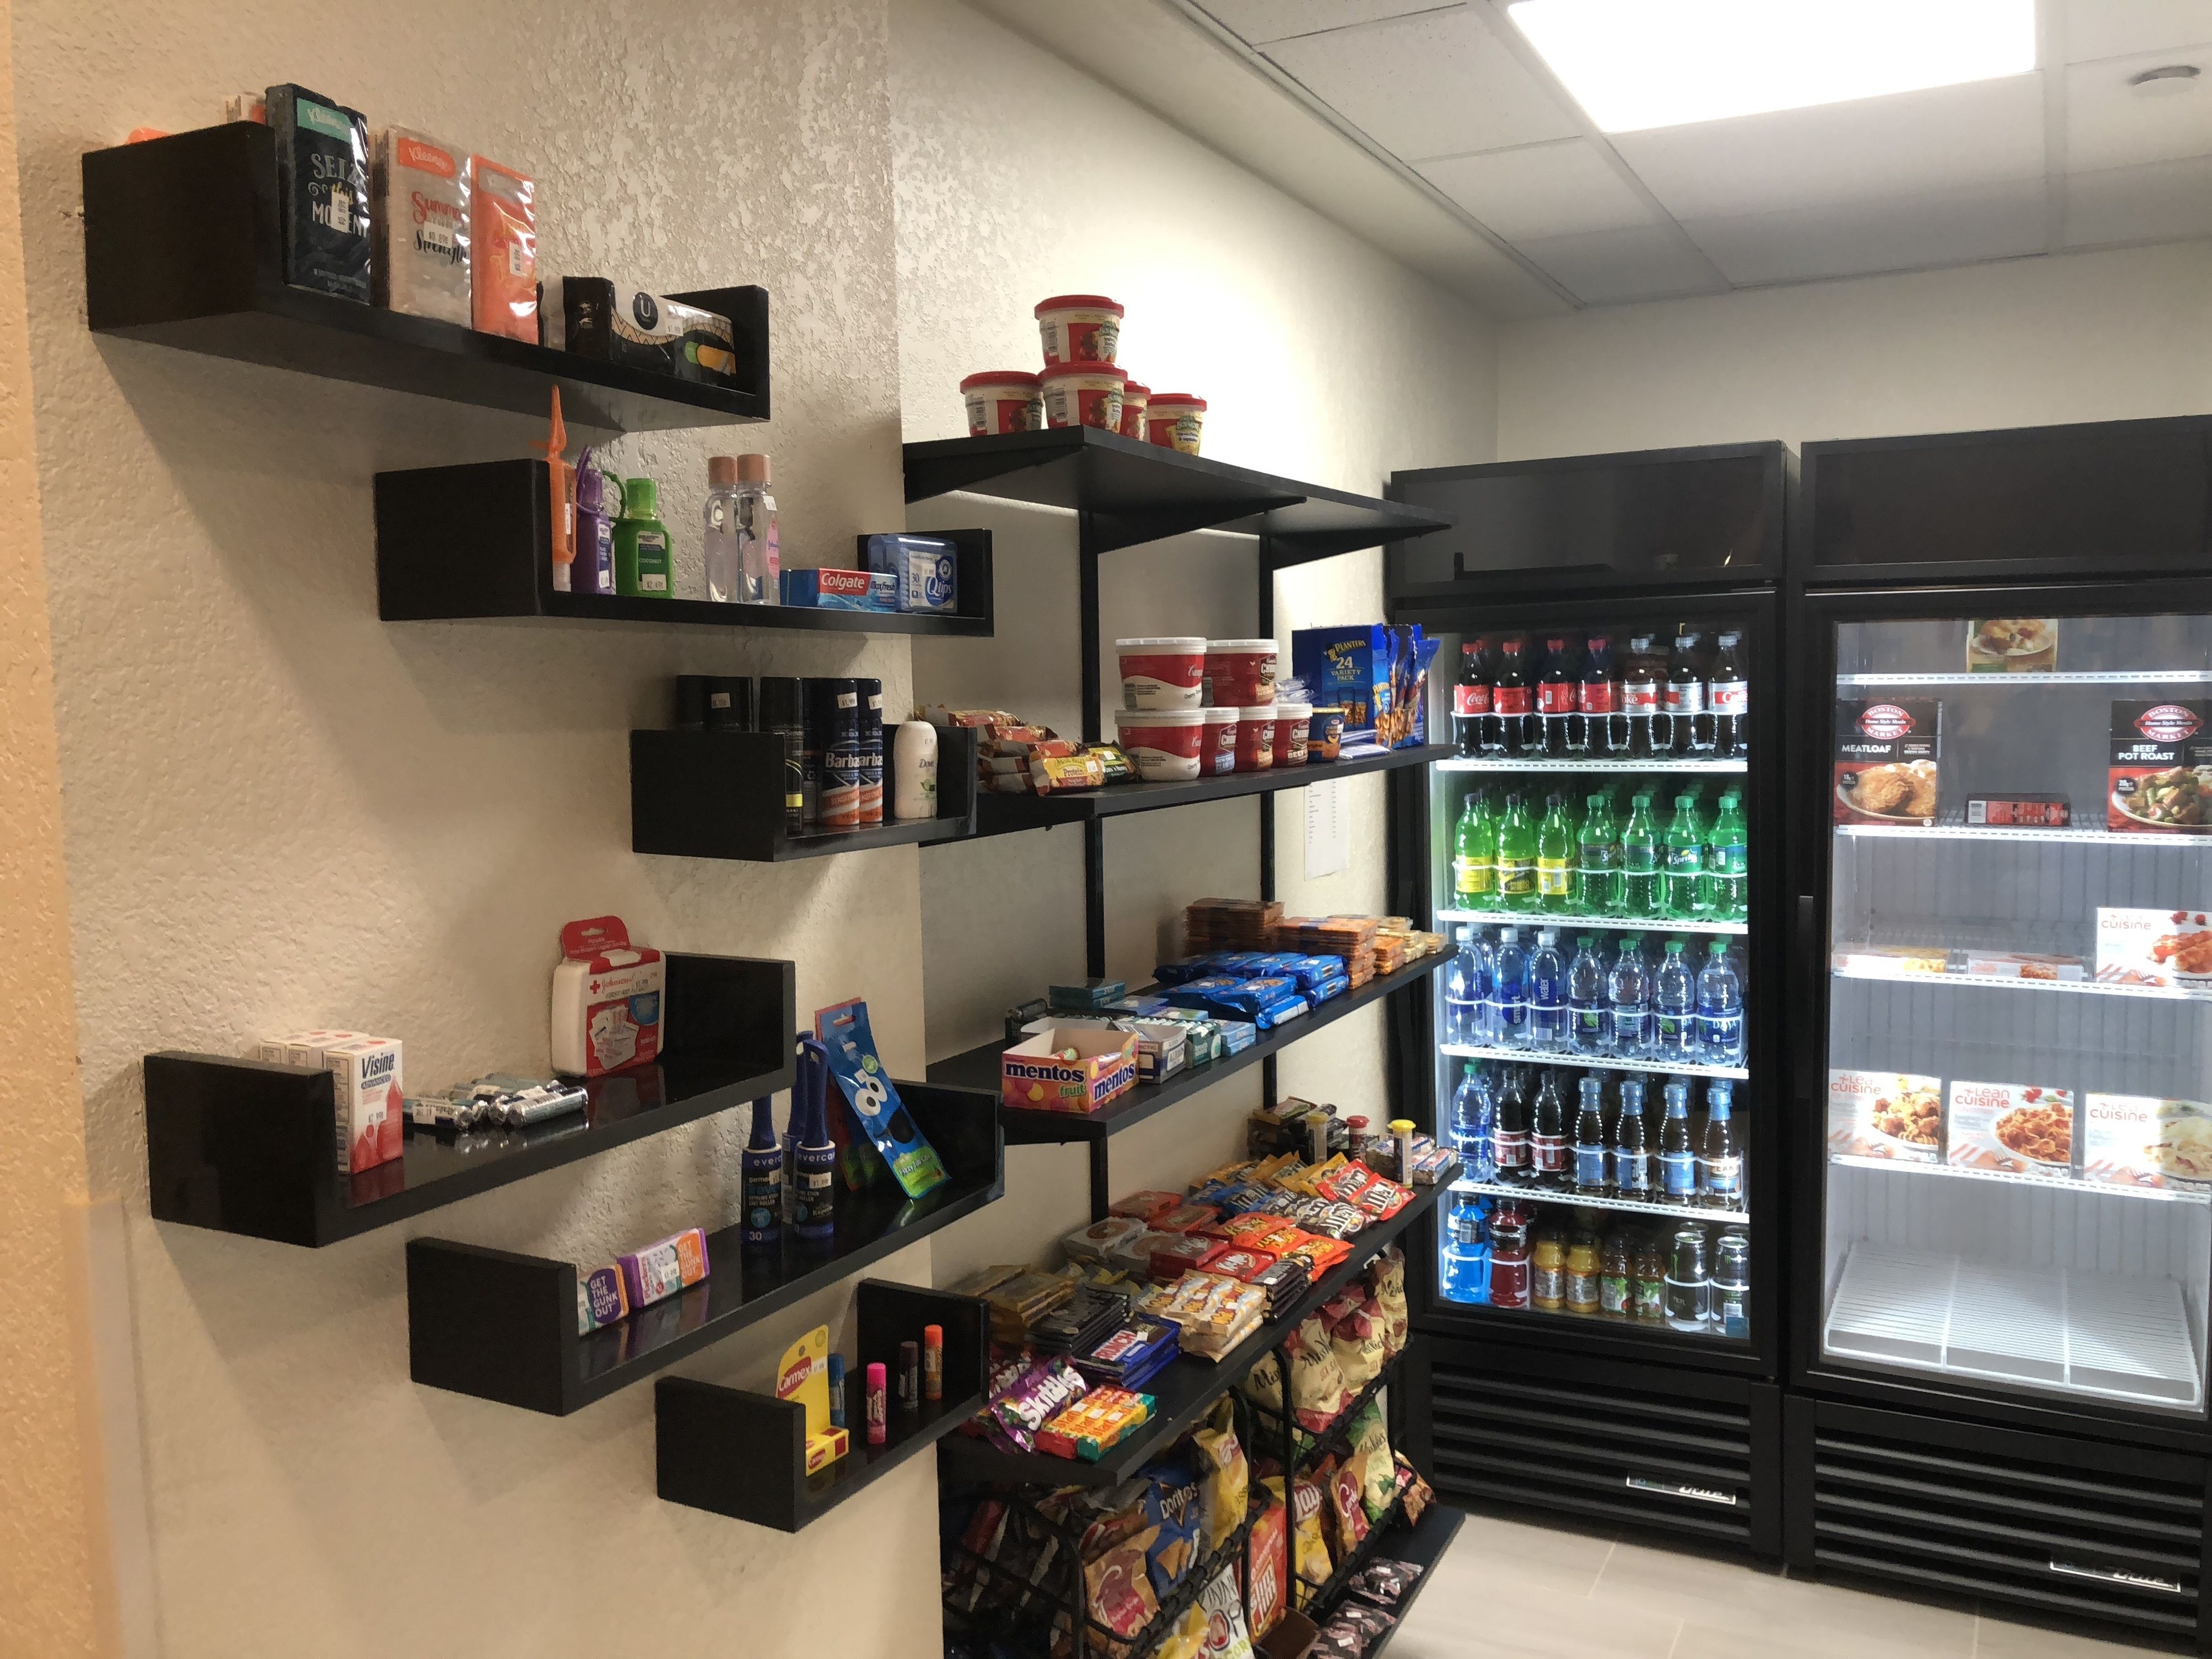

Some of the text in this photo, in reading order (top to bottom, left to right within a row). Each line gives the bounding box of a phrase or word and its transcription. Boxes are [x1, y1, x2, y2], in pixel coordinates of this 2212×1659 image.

[821, 572, 865, 591] Colgate
[1334, 640, 1366, 652] PLANTERS
[1336, 656, 1353, 670] 24
[1867, 707, 1905, 717] BOSTON
[2147, 707, 2191, 718] BOSTON
[1866, 727, 1904, 737] MARKET
[2147, 729, 2190, 740] MARKET
[1841, 744, 1892, 754] MEATLOAF
[2132, 744, 2158, 753] BEEF
[2118, 752, 2176, 760] POT ROAST
[919, 758, 934, 768] Dove
[1063, 768, 1084, 778] Protein
[1539, 978, 1550, 1000] water
[362, 1052, 395, 1079] Visine
[1006, 1062, 1085, 1082] mentos
[1094, 1063, 1135, 1100] mentos
[1059, 1084, 1087, 1097] fruit
[1975, 1087, 2011, 1099] Lean
[749, 1231, 762, 1241] 30
[678, 1240, 692, 1252] GET
[680, 1249, 692, 1262] THE
[681, 1256, 701, 1270] GUNK
[681, 1266, 697, 1279] OUT
[591, 1275, 607, 1289] GET
[592, 1287, 609, 1298] THE
[593, 1292, 618, 1307] GUNK
[595, 1305, 614, 1318] OUT
[778, 1365, 811, 1391] Carmex
[1019, 1365, 1087, 1431] Skittles
[1160, 1483, 1199, 1520] Doritos
